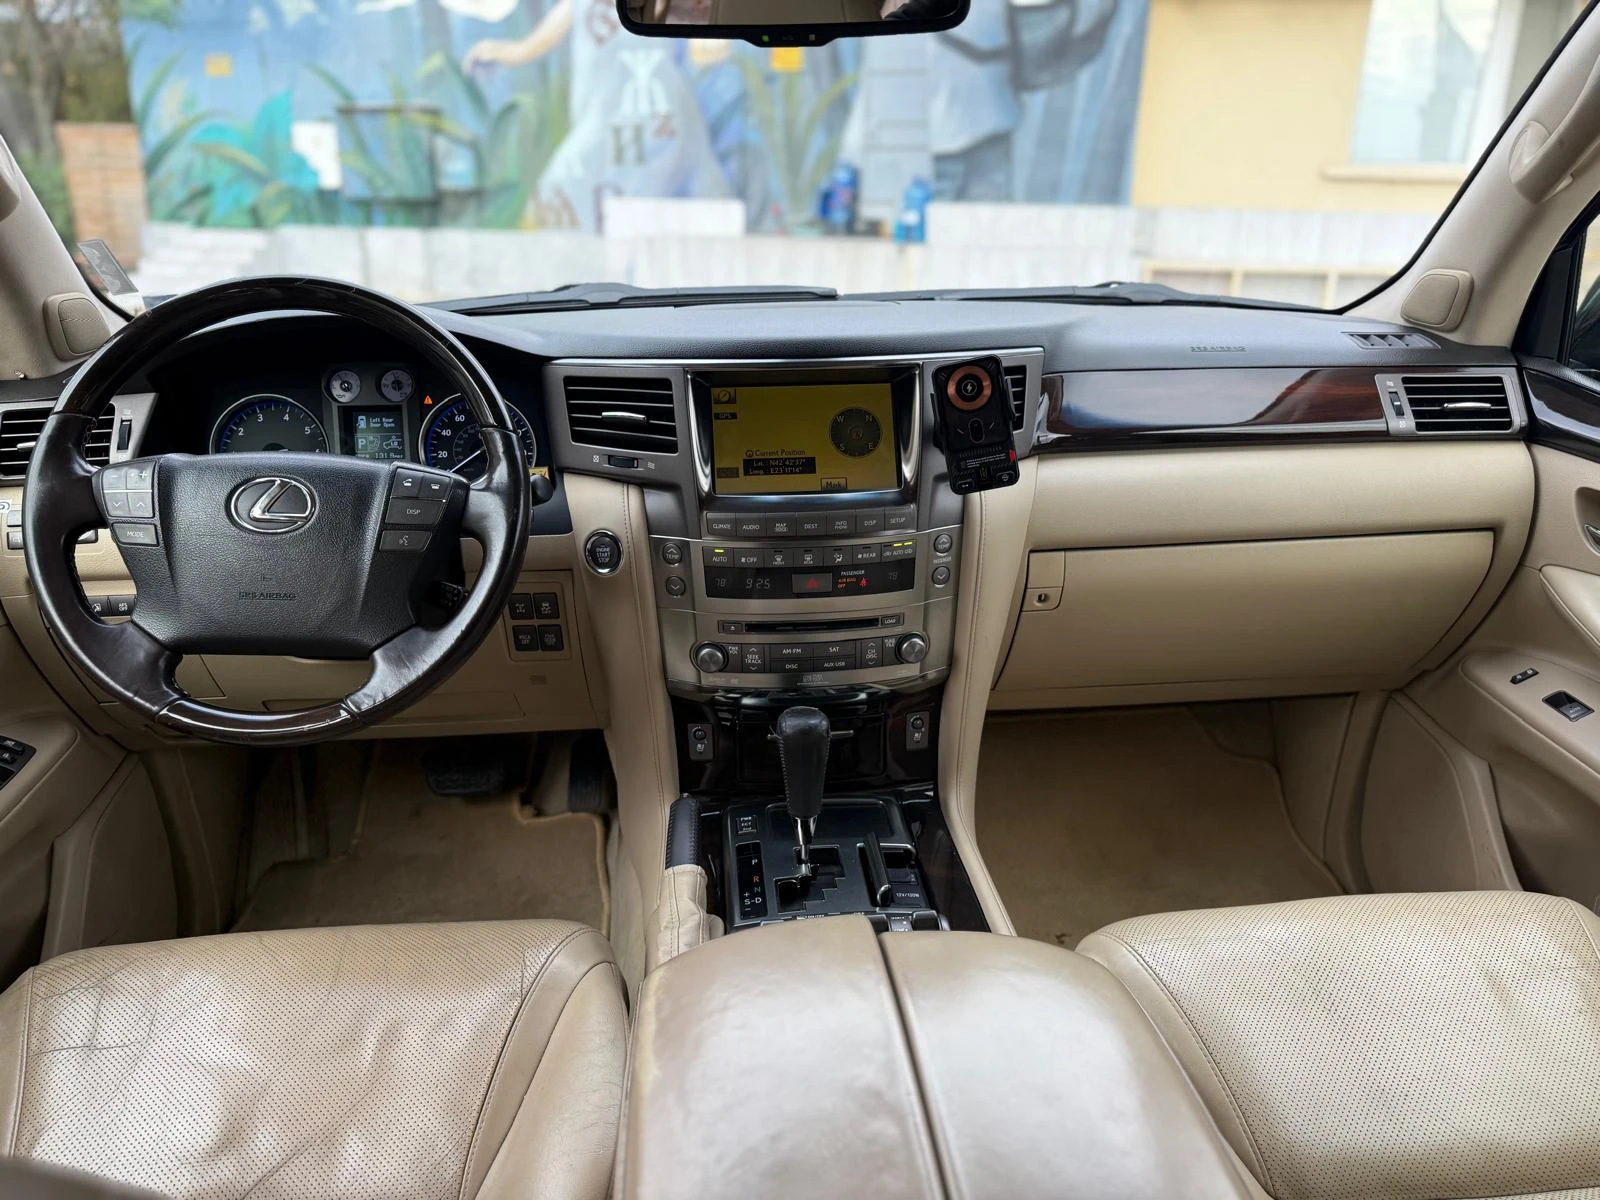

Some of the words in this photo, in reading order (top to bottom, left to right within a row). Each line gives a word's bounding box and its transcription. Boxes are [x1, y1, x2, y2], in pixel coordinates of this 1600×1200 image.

[257, 413, 264, 423] 3
[283, 413, 290, 422] 4
[454, 414, 466, 422] 60
[836, 415, 845, 423] W
[238, 427, 245, 436] 2
[304, 426, 311, 435] 5
[441, 429, 452, 437] 40
[358, 438, 366, 449] P
[839, 443, 846, 452] S
[868, 442, 874, 450] E
[437, 450, 448, 458] 20
[755, 449, 779, 457] Current
[780, 448, 806, 456] Position
[406, 507, 421, 515] DISP
[126, 530, 145, 538] MODE
[258, 592, 297, 600] AIRBAG
[752, 875, 760, 883] R
